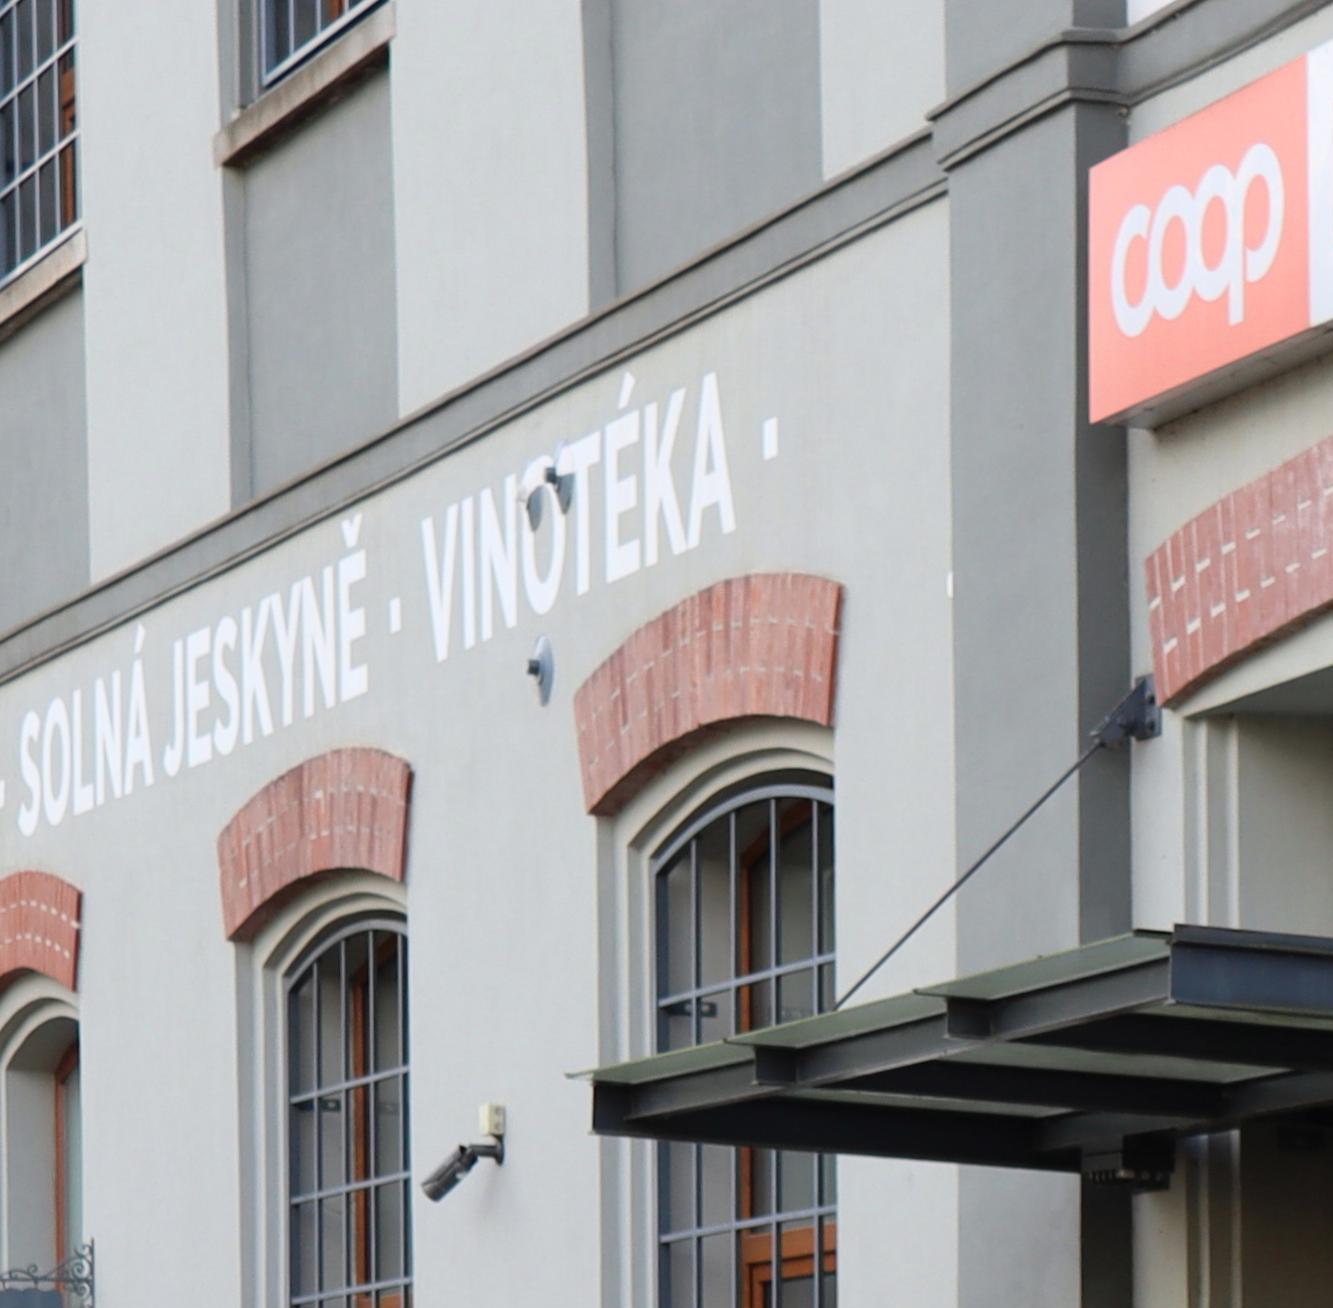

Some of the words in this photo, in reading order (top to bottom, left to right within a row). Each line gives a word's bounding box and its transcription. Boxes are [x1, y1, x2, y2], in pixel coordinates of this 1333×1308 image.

[1110, 142, 1284, 338] coop
[17, 625, 154, 838] SOLNÁ
[164, 514, 369, 778] JESKYNĚ
[421, 371, 737, 663] VINOTÉKA
